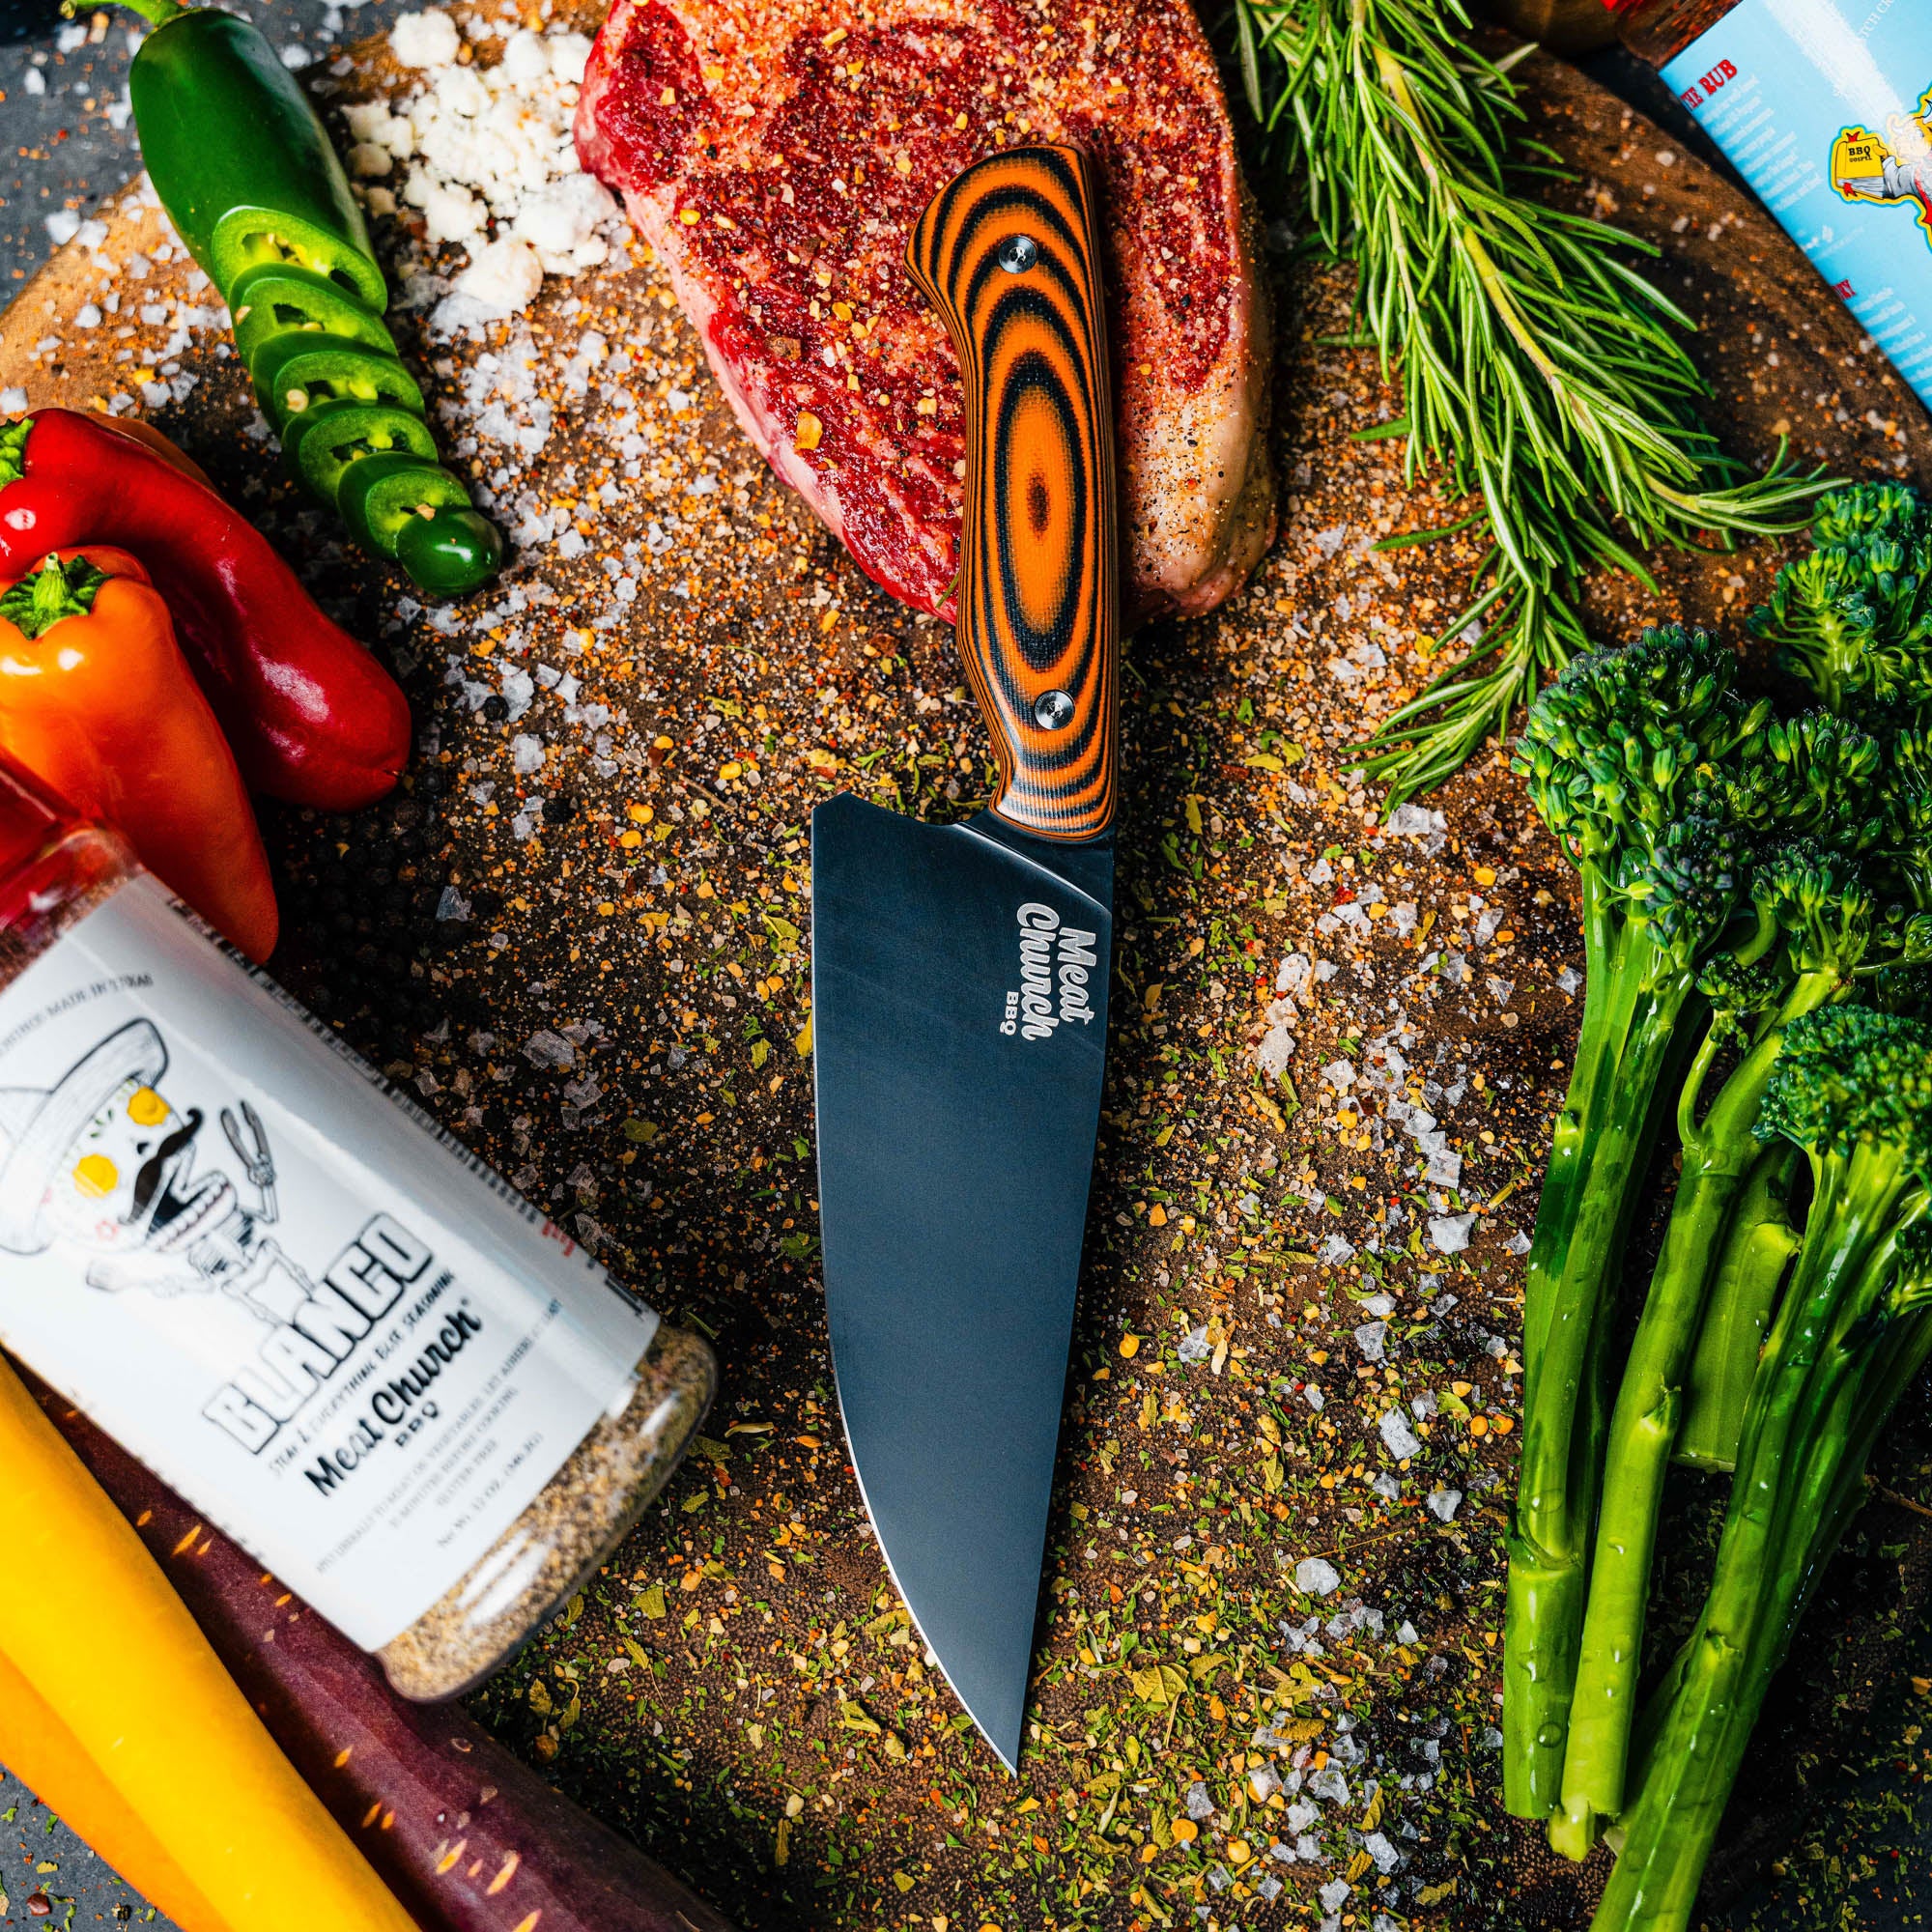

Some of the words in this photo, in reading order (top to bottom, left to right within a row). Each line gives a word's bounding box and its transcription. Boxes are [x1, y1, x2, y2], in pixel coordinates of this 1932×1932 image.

[1698, 59, 1738, 96] RUB
[1848, 146, 1871, 158] BBQ
[999, 991, 1019, 1036] BBQ
[1016, 902, 1061, 1041] Church
[1057, 927, 1097, 1025] Meat
[201, 1211, 434, 1455] BLANCO
[304, 1419, 384, 1497] Meat
[371, 1310, 483, 1425] Church
